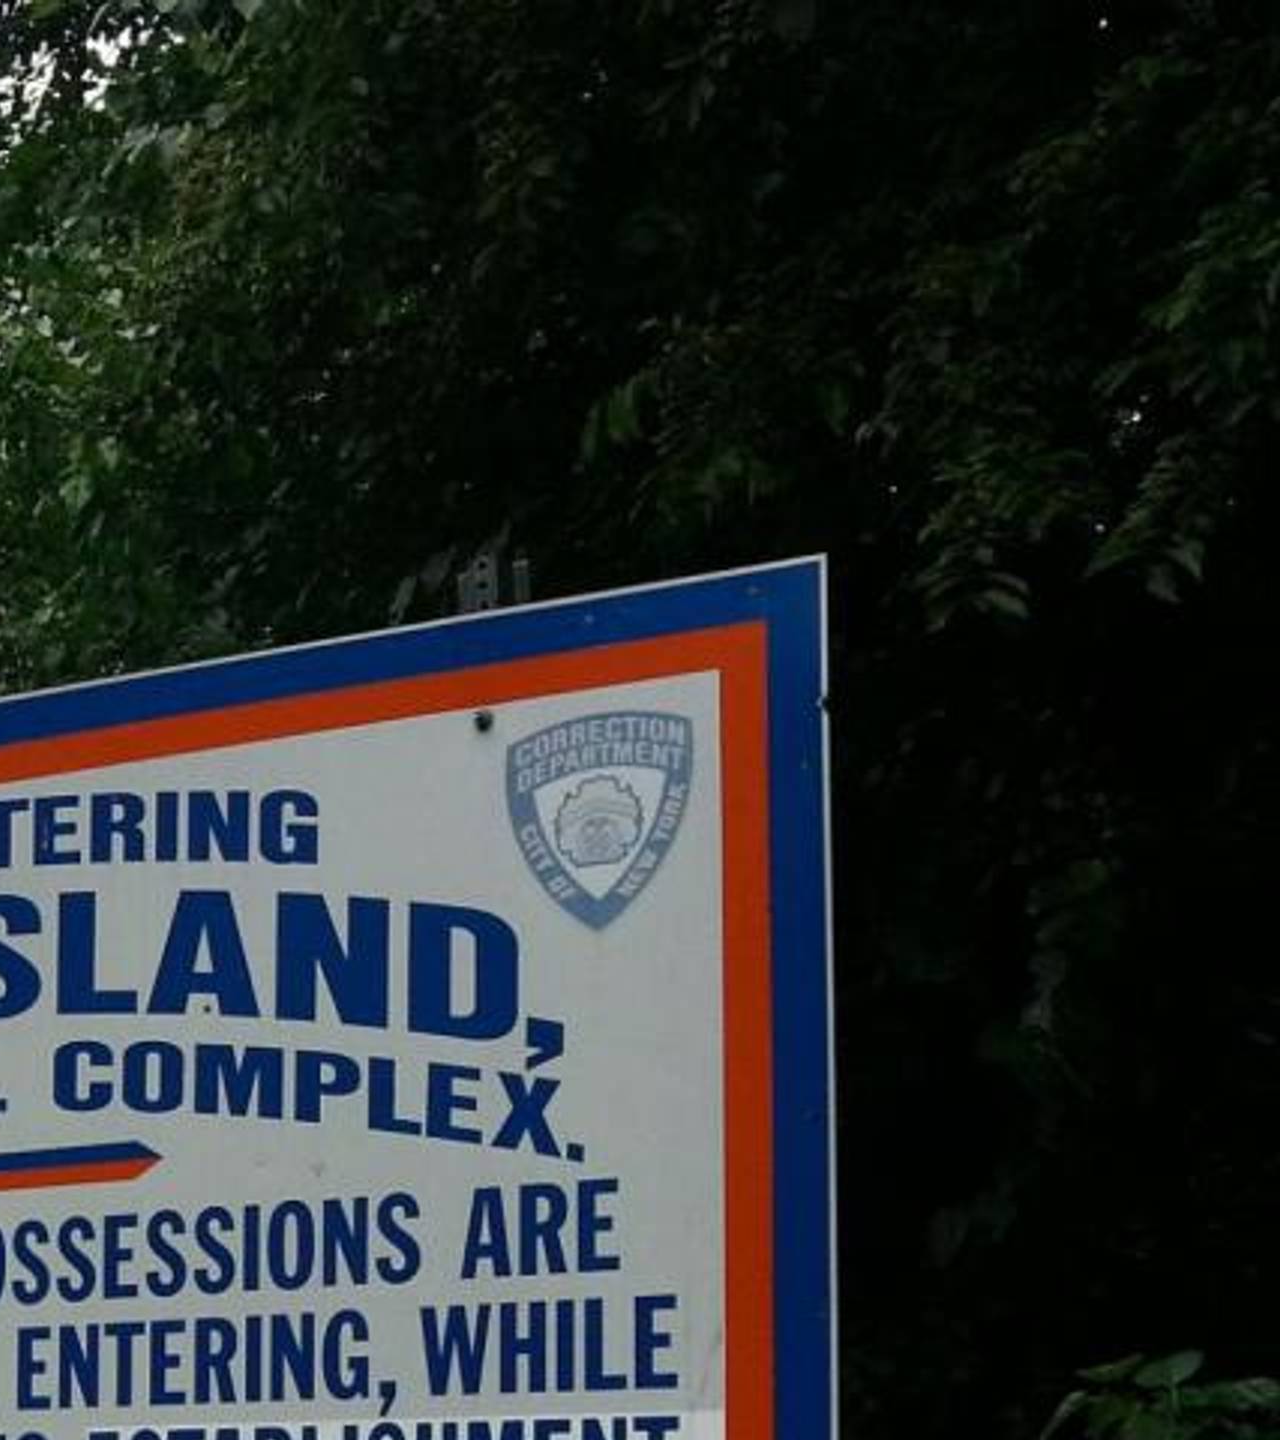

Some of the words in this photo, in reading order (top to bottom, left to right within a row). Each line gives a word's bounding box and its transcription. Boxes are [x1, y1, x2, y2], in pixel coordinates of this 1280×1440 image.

[515, 717, 686, 766] CORRECTION
[516, 742, 684, 792] DEPARTMENT
[53, 1040, 584, 1163] COMPLEX.
[461, 1177, 620, 1280] ARE
[17, 1309, 396, 1417] ENTERING,
[420, 1294, 678, 1396] WHILE
